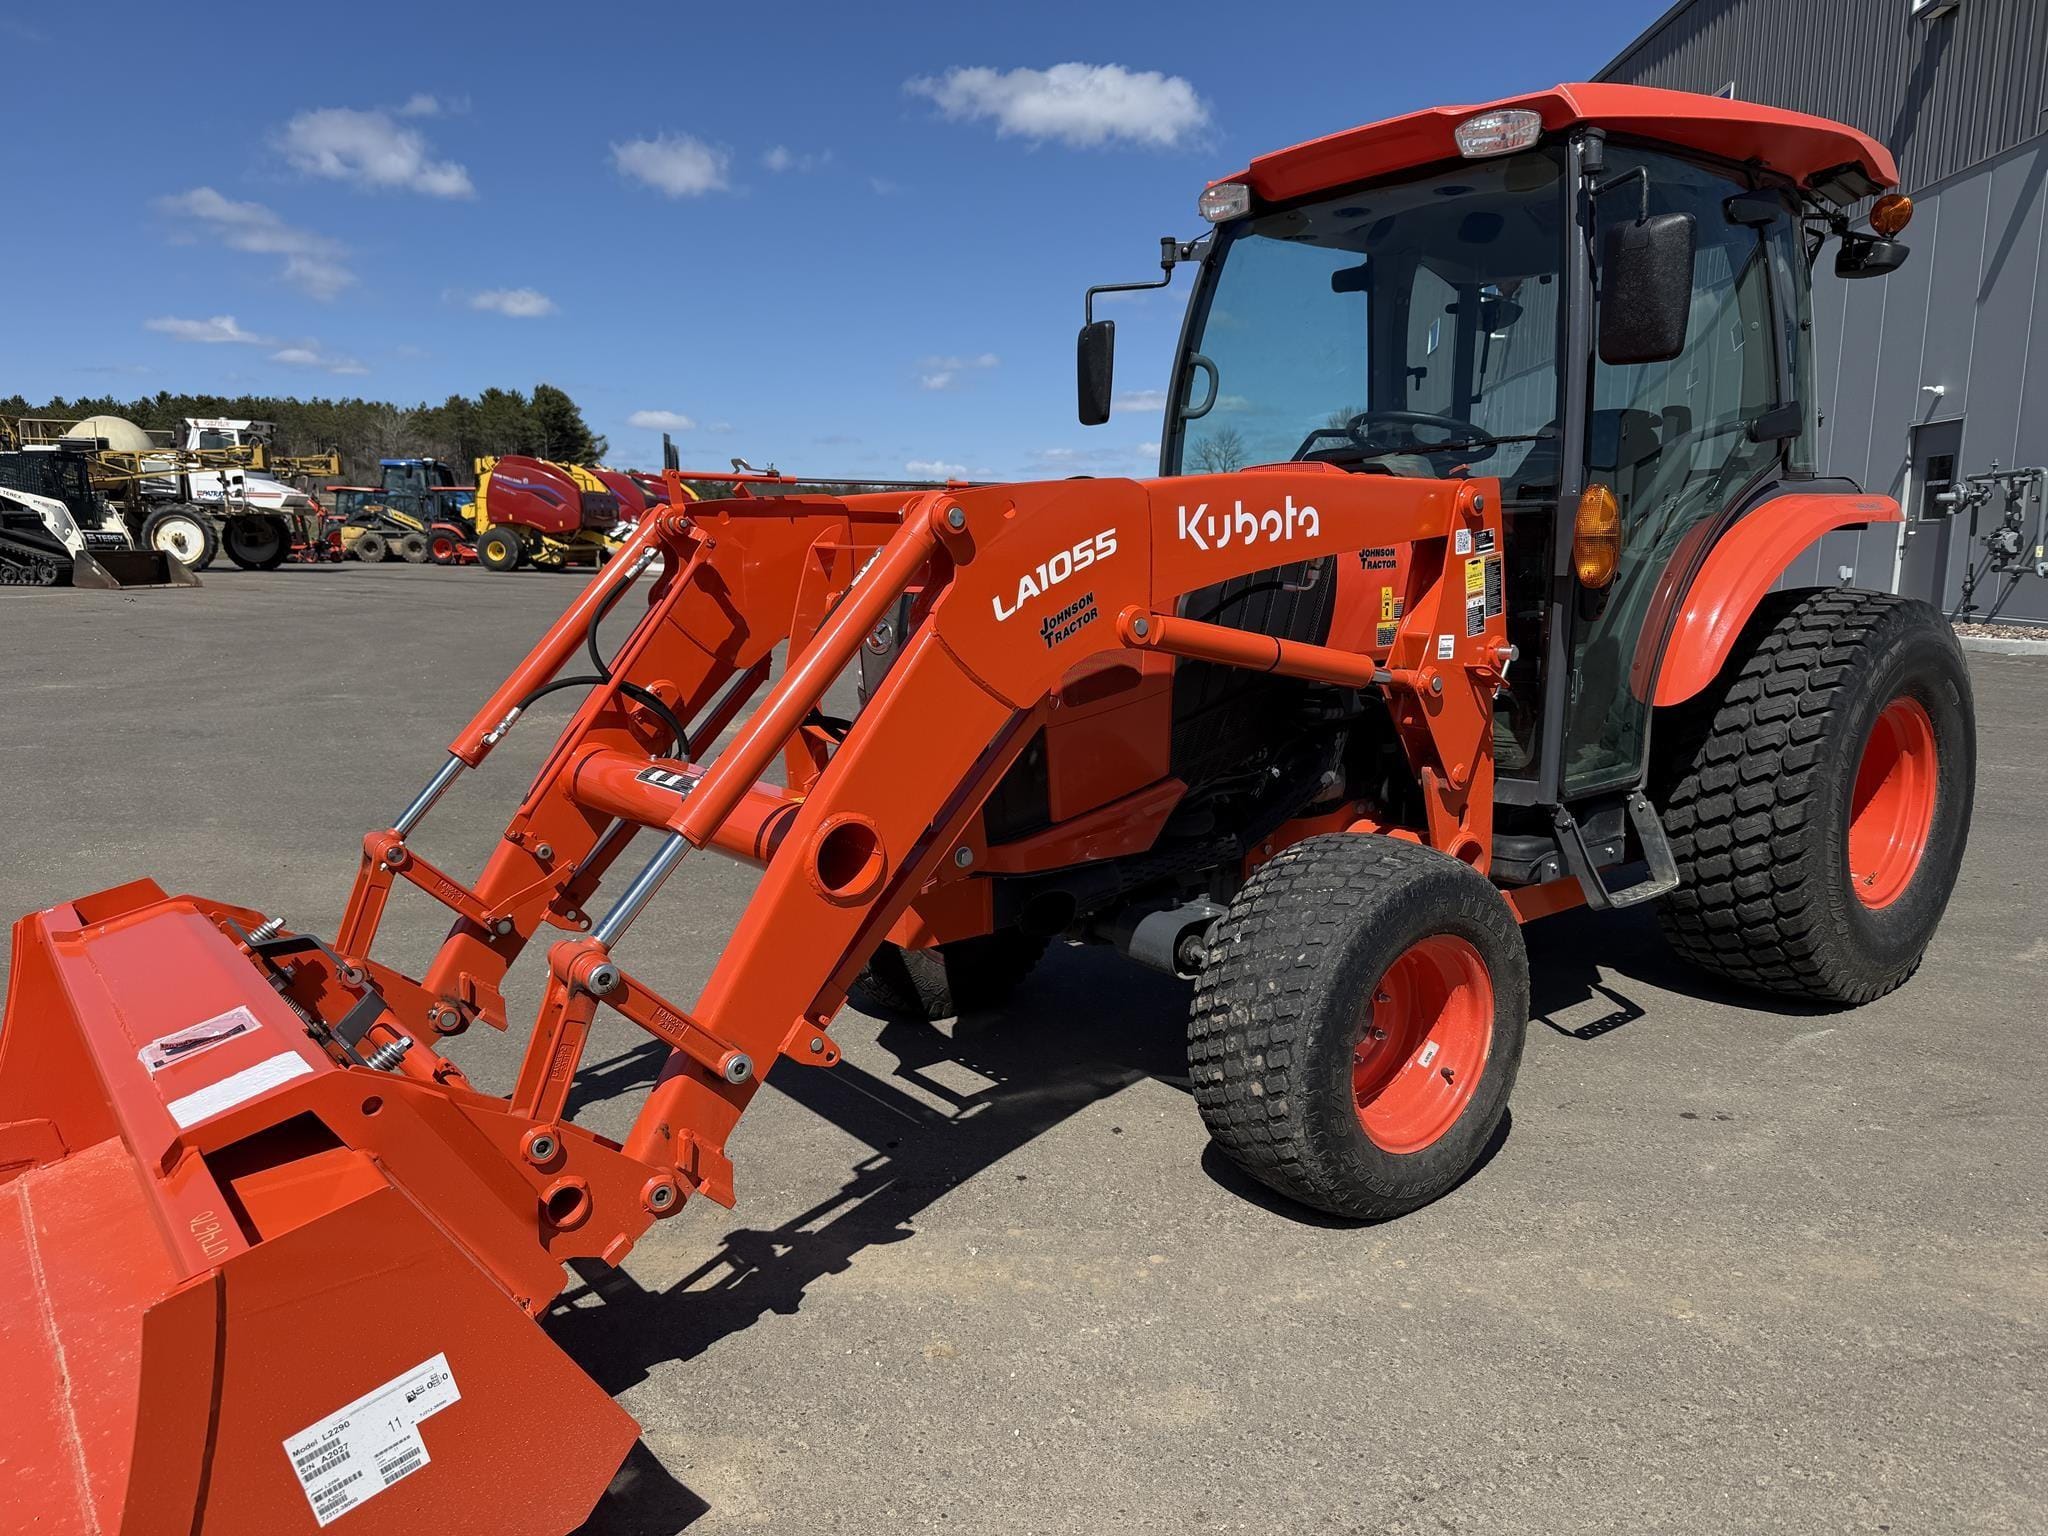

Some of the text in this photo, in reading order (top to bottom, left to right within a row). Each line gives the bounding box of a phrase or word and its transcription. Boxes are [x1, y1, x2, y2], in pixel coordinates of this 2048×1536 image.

[1178, 495, 1320, 550] Kubota
[1359, 548, 1396, 558] JOHNSON
[1360, 558, 1397, 570] TRACTOR
[992, 528, 1118, 622] LA1055
[1039, 592, 1095, 636] JOHNSON
[1043, 608, 1099, 649] TRACTOR
[1341, 1148, 1397, 1198] TRAC
[292, 1420, 351, 1457] Model L2290
[388, 1416, 402, 1432] 11
[300, 1442, 349, 1475] S/N A2027
